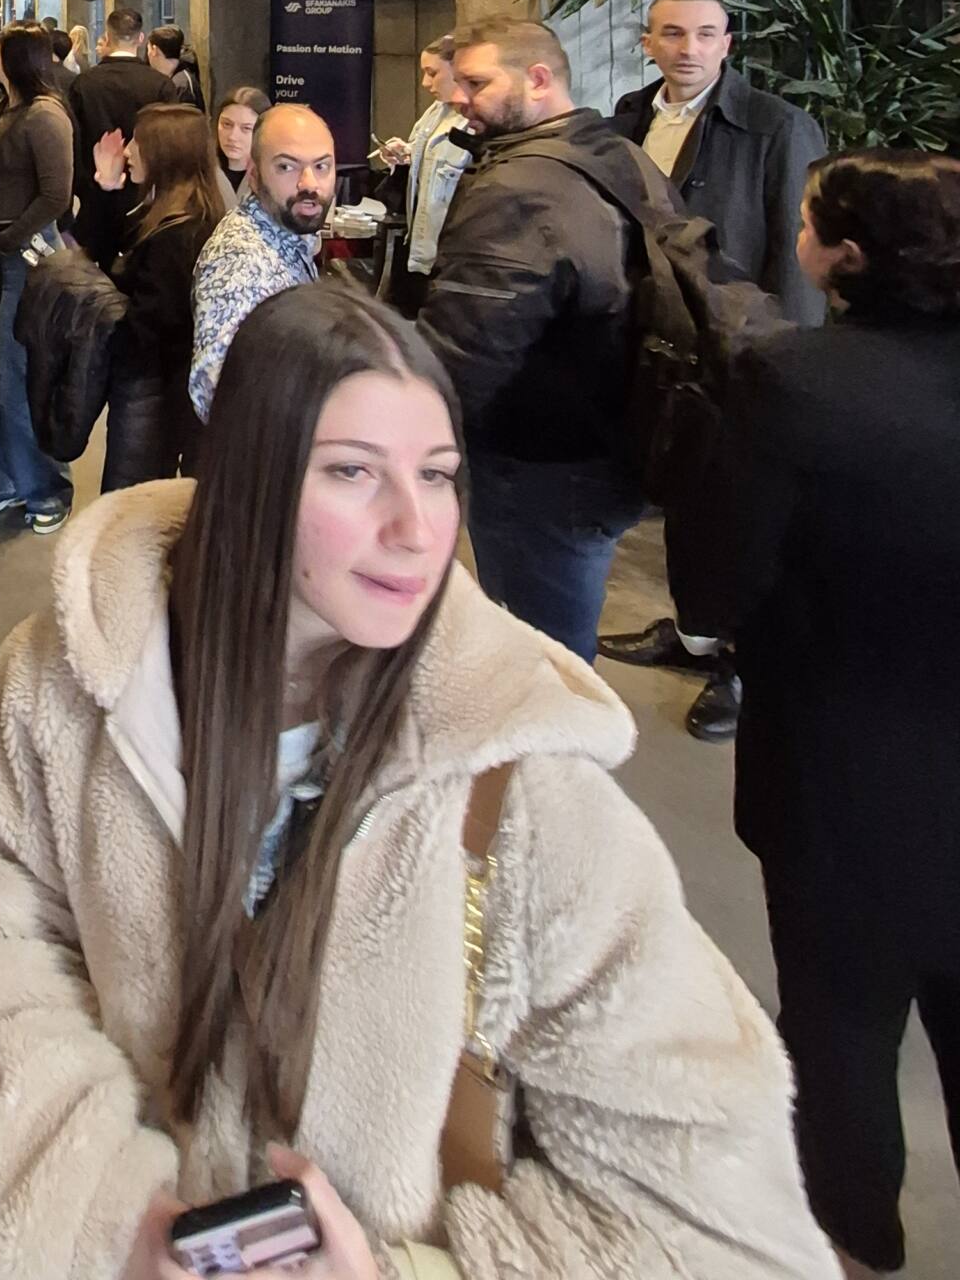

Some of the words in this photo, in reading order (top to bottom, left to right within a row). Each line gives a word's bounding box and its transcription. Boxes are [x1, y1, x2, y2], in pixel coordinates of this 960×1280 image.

[276, 44, 311, 53] Passion
[313, 45, 327, 53] for
[328, 45, 362, 54] Motion
[276, 75, 305, 85] Drive
[275, 89, 298, 98] your
